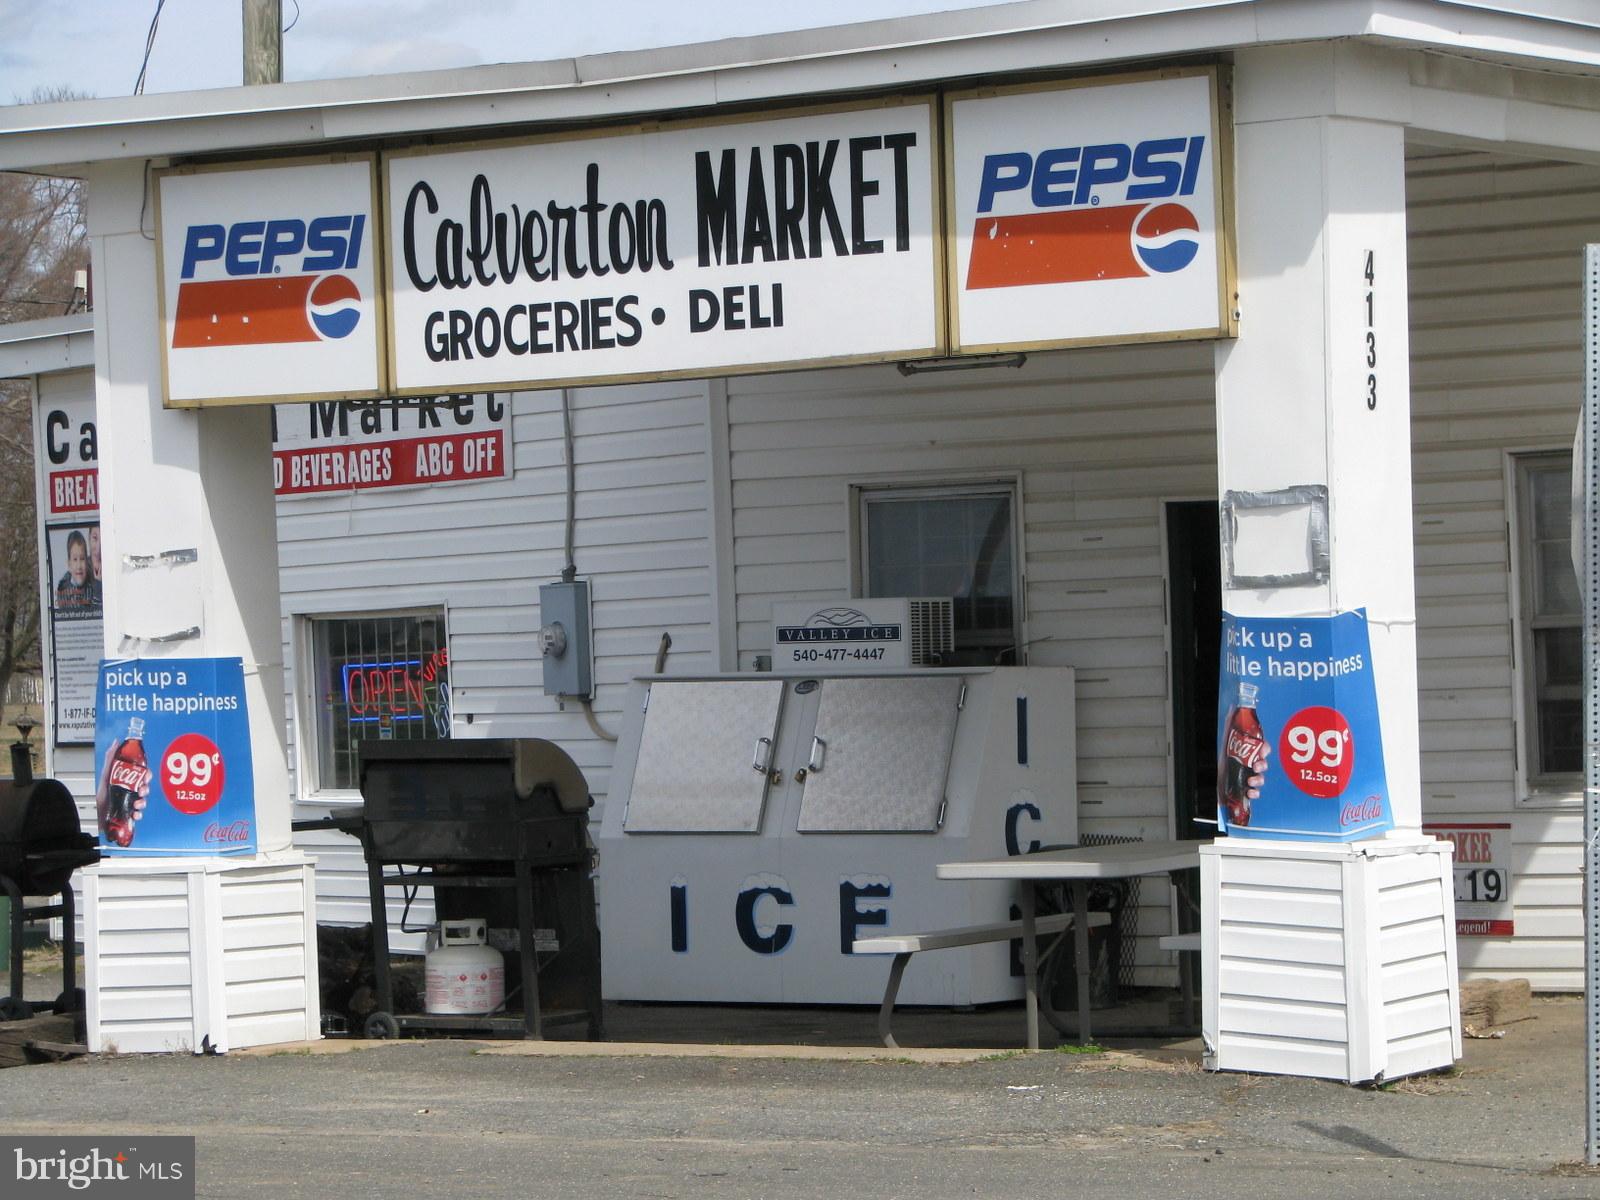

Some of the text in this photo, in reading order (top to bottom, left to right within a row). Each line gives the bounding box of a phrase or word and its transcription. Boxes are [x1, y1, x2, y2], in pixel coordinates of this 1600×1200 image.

[976, 135, 1206, 214] PEPSI
[403, 131, 917, 293] Calverton MARKET
[180, 214, 367, 279] PEPSI
[424, 282, 784, 363] GROCERIES DELI
[1363, 250, 1377, 411] 4133
[54, 474, 100, 508] BREA
[291, 446, 393, 489] BEVERAGES
[415, 440, 454, 478] ABC
[462, 436, 497, 474] OFF
[785, 627, 893, 641] VALLEY ICE
[1261, 632, 1293, 651] up
[1299, 631, 1313, 648] a
[792, 648, 886, 662] 540-477-4447
[1226, 653, 1363, 681] little happiness
[105, 667, 188, 689] pick up a
[350, 670, 425, 714] OPEN
[106, 692, 238, 715] little happiness
[1300, 768, 1338, 785] 12.5oz
[176, 790, 207, 801] 12.5oz
